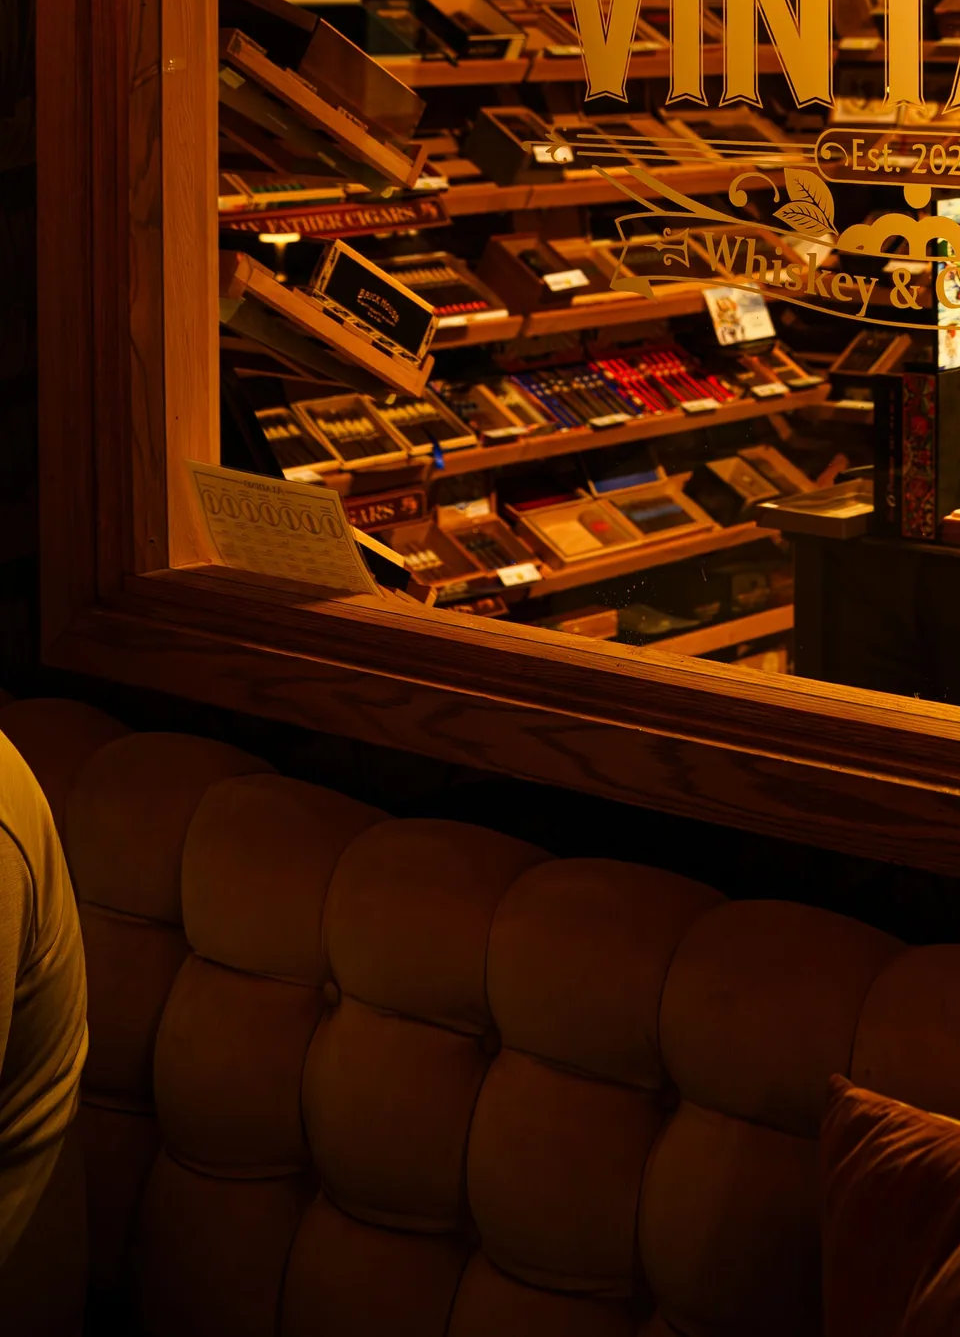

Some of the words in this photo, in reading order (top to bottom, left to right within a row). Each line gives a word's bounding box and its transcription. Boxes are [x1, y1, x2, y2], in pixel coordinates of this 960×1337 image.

[852, 138, 900, 173] Est.
[265, 214, 344, 234] FATHER
[345, 206, 417, 227] CIGARS
[702, 231, 879, 318] Whiskey
[889, 267, 923, 310] &
